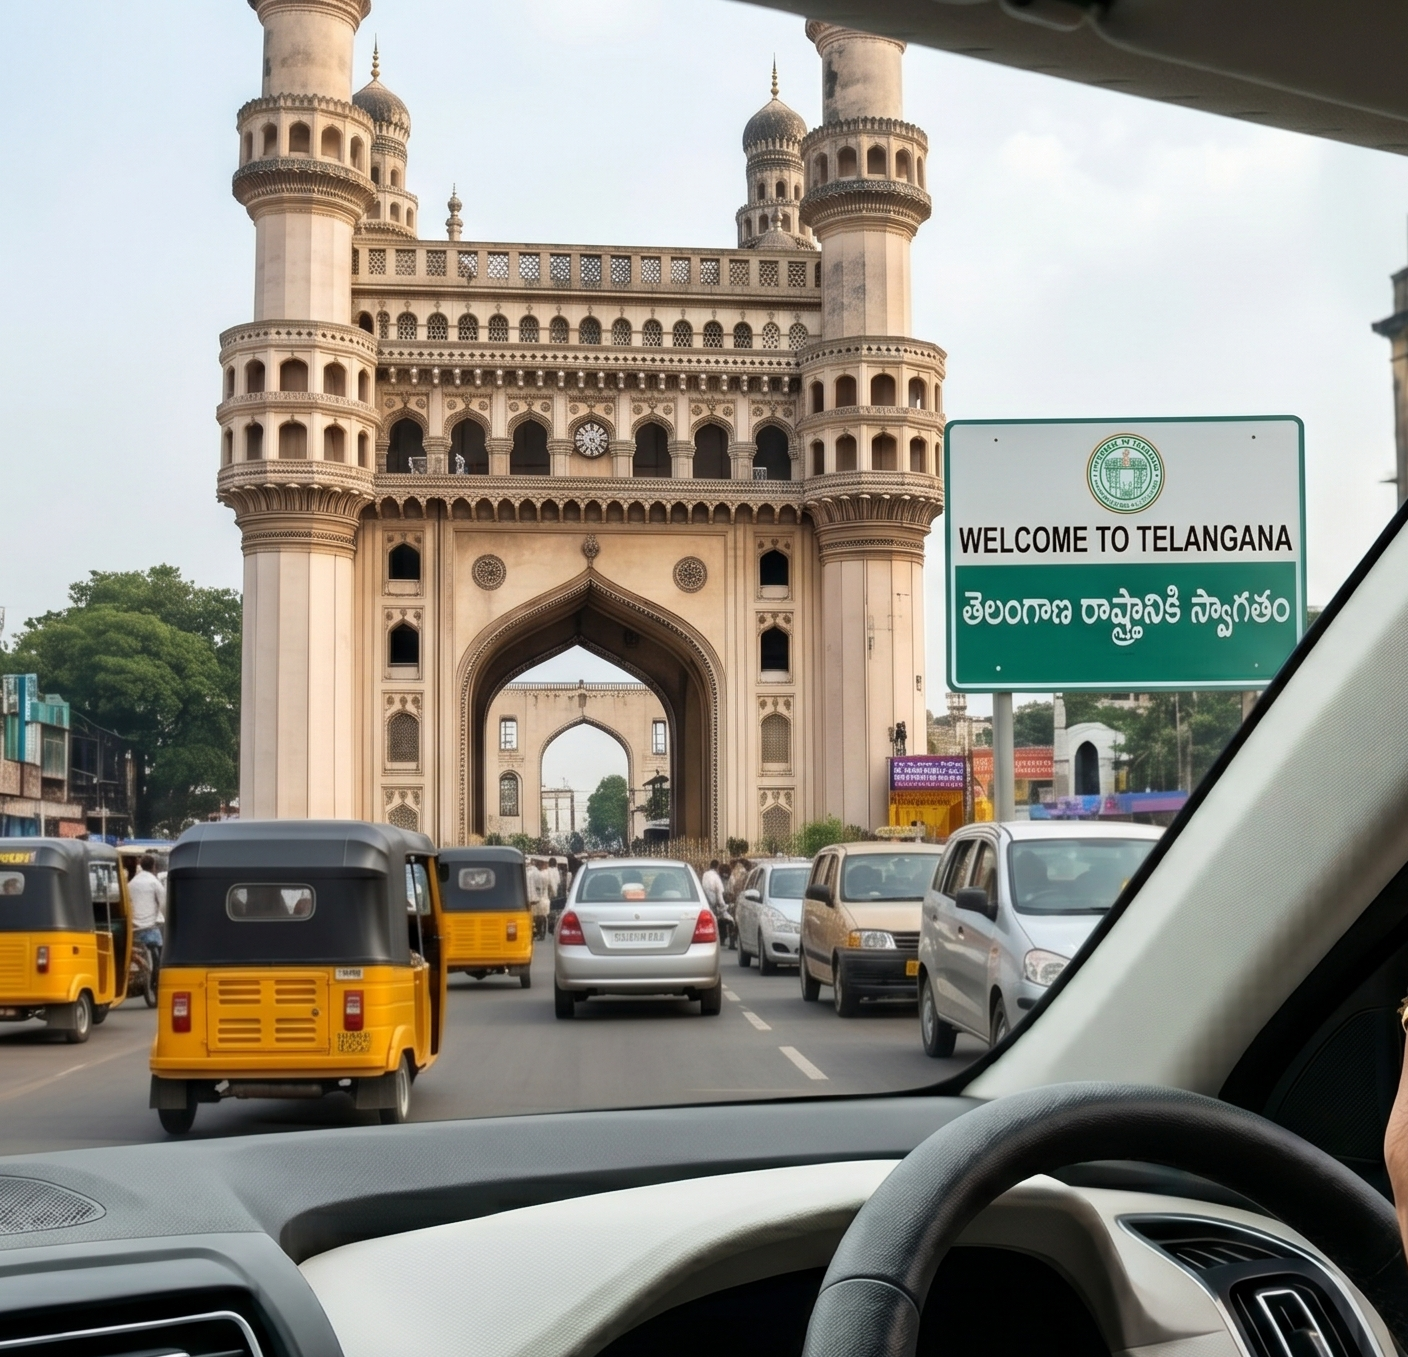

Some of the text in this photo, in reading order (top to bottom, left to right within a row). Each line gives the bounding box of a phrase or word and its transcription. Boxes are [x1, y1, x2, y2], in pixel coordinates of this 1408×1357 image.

[959, 524, 1293, 554] WELCOME TO TELANGANA
[962, 591, 1072, 625] తెలంగాణ
[1191, 588, 1291, 638] స్వాగతం
